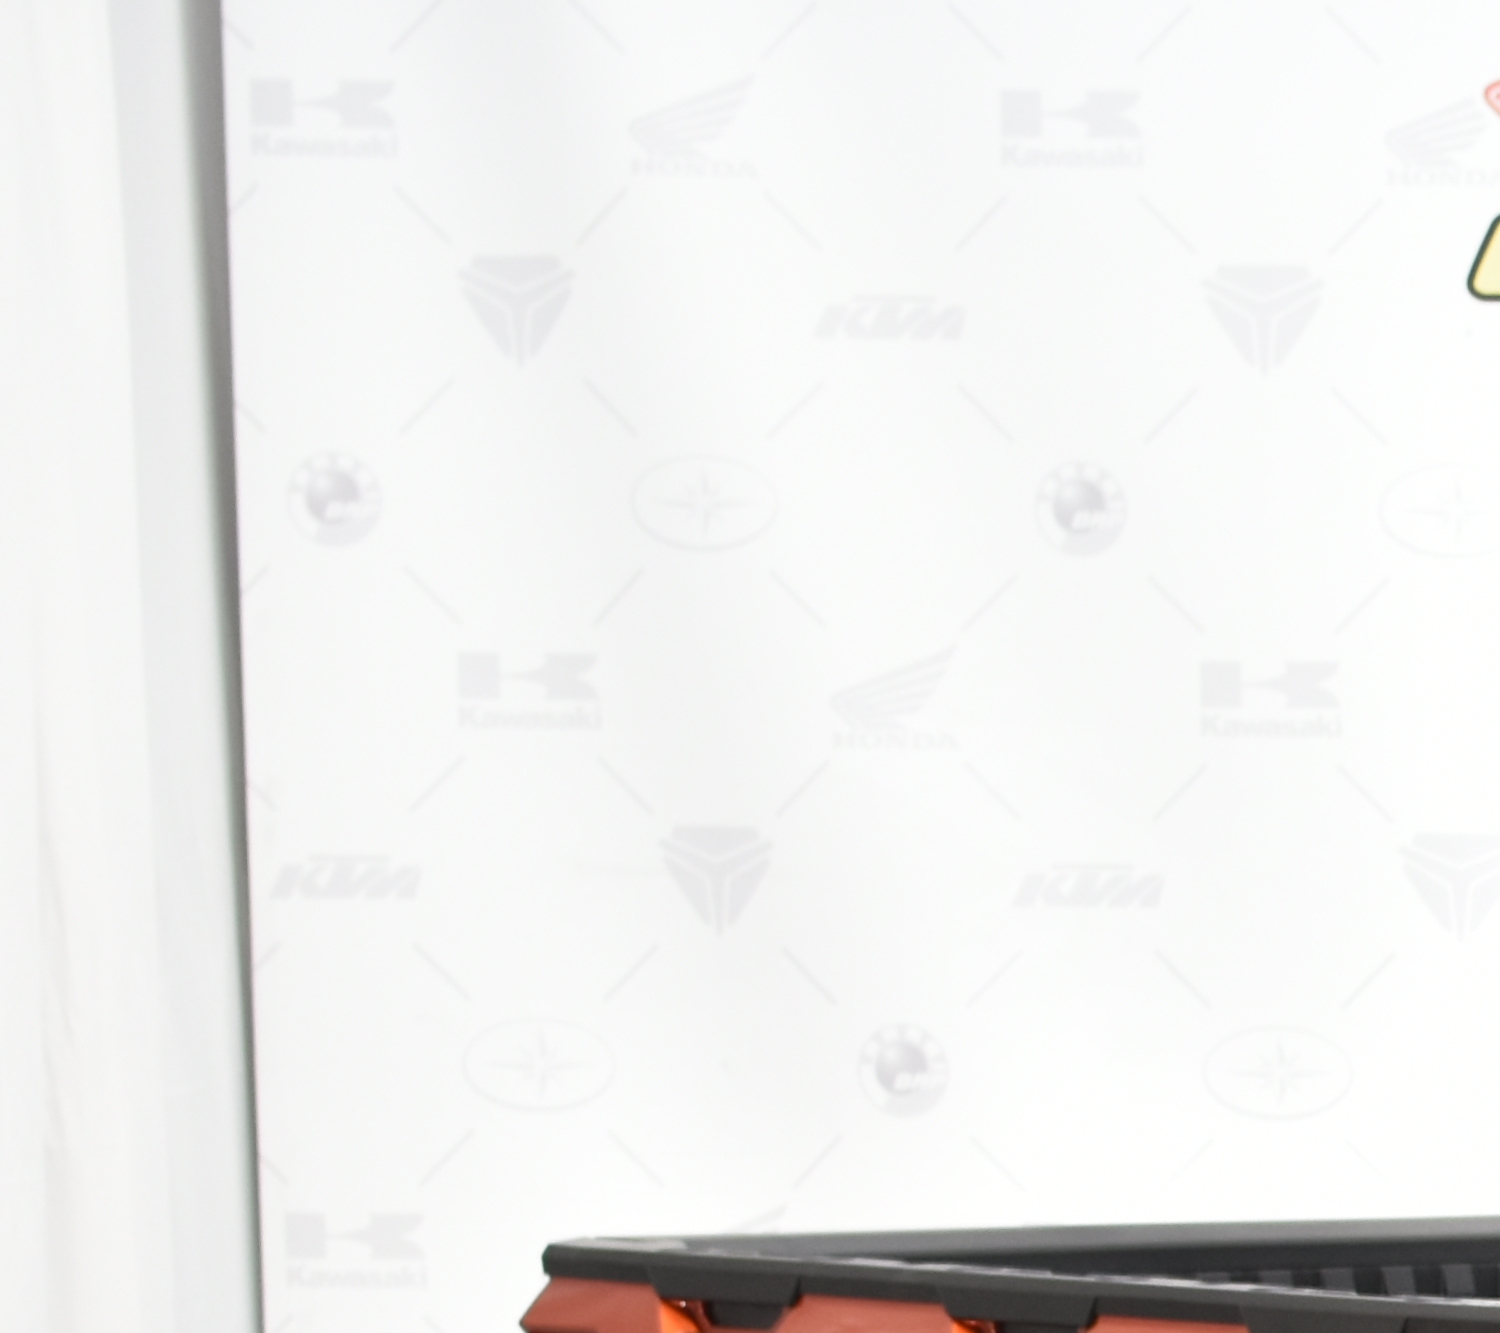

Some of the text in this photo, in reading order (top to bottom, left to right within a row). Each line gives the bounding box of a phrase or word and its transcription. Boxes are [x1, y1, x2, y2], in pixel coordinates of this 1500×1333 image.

[815, 294, 966, 339] KTM
[272, 854, 422, 900] KTM
[1013, 864, 1166, 909] KTM
